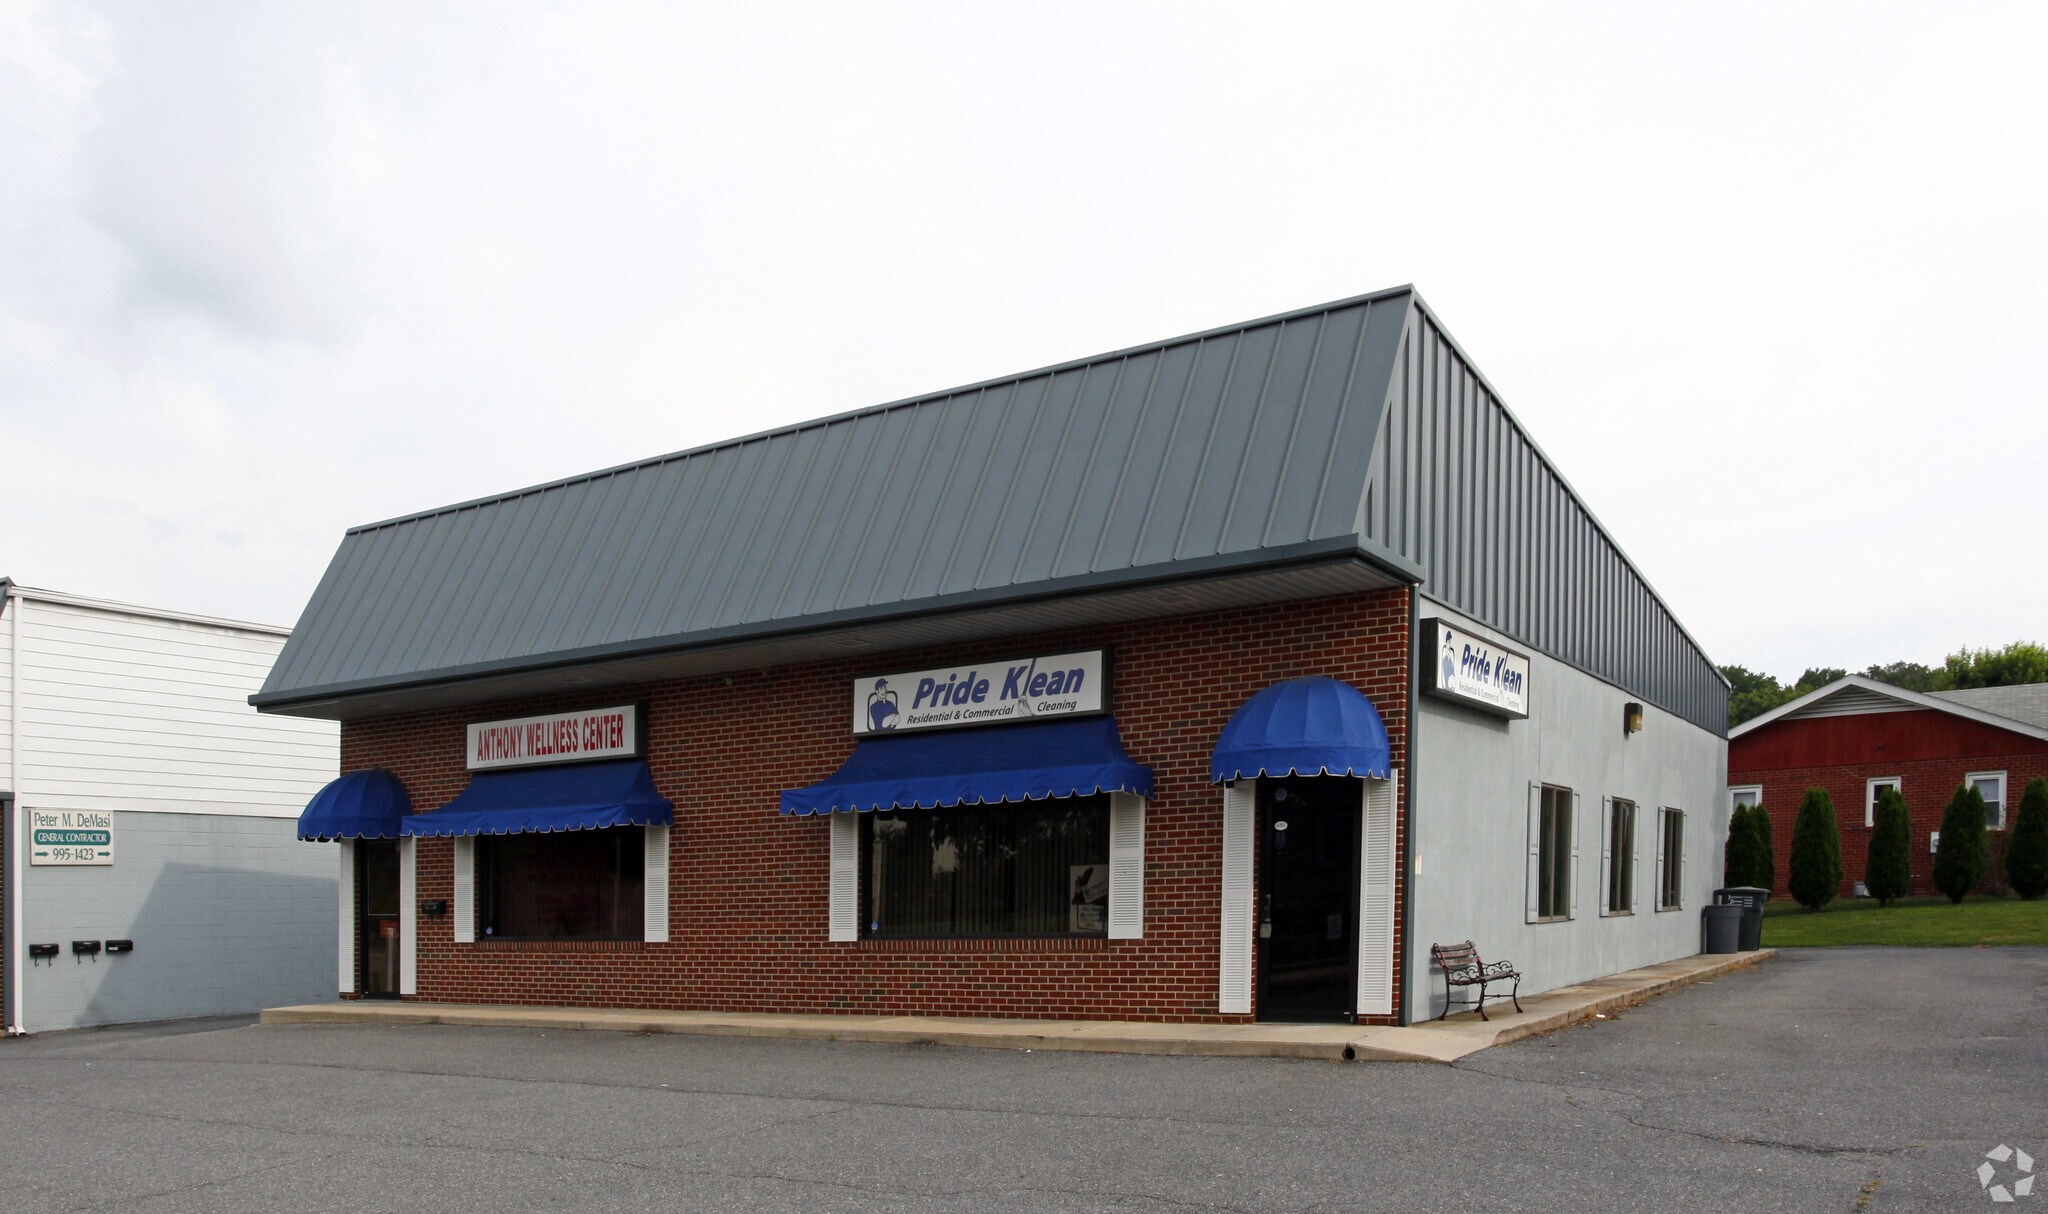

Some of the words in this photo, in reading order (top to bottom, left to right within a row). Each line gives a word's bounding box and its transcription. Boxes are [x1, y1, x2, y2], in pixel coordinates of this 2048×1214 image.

[1460, 643, 1491, 684] Pride
[1493, 651, 1522, 695] Klean
[911, 671, 990, 710] Pride
[1000, 657, 1085, 700] Klean
[906, 708, 953, 725] Residential
[954, 710, 961, 720] &
[963, 705, 1015, 720] Commercial
[1037, 700, 1078, 713] Cleaning
[477, 725, 523, 762] ANTHONY
[526, 718, 579, 757] WELLNESS
[582, 713, 624, 751] CENTER
[34, 812, 58, 827] Peter
[62, 813, 74, 827] M.
[77, 812, 111, 828] DeMasi
[38, 832, 65, 842] GENERAL
[66, 832, 107, 843] CONTRACTOR
[52, 848, 94, 861] 995-1423
